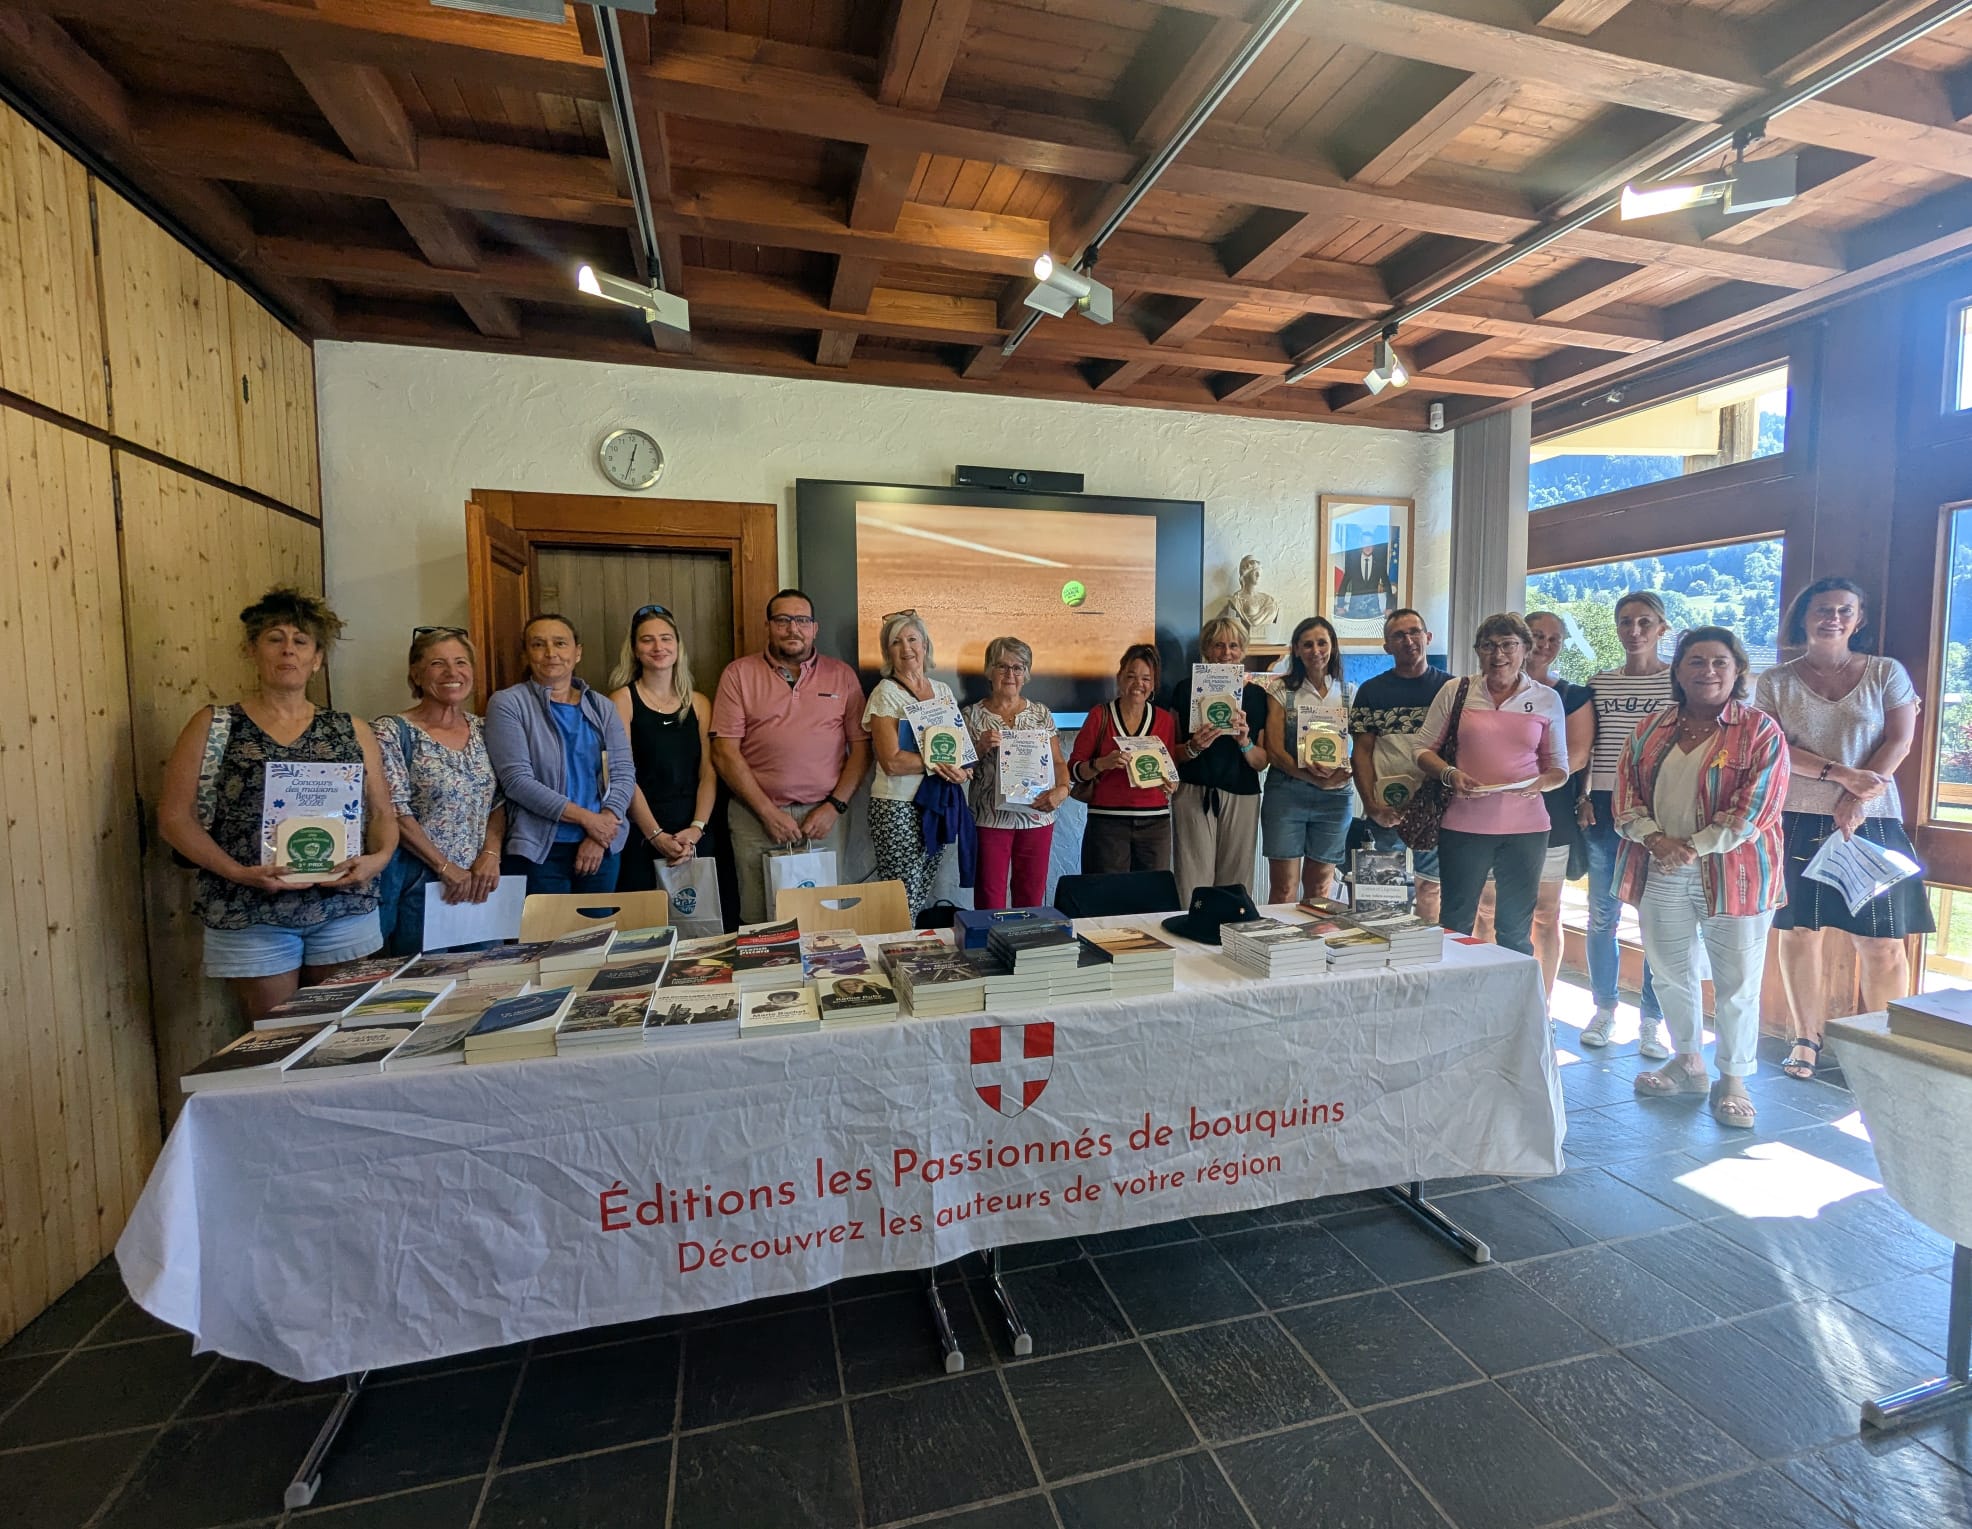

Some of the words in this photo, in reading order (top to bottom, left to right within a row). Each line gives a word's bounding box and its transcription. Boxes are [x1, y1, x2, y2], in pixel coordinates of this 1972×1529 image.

[292, 778, 333, 786] Concours
[296, 792, 327, 800] fleuries
[673, 897, 697, 907] Praz
[600, 1181, 795, 1232] Éditions
[817, 1158, 872, 1197] les
[895, 1127, 1113, 1187] Passionnés
[1129, 1113, 1173, 1150] de
[1190, 1099, 1344, 1141] bouquins
[679, 1220, 864, 1273] Découvrez
[881, 1209, 923, 1235] les
[937, 1189, 1051, 1227] auteurs
[1065, 1178, 1100, 1203] de
[1115, 1171, 1184, 1196] votre
[1197, 1151, 1282, 1185] région
